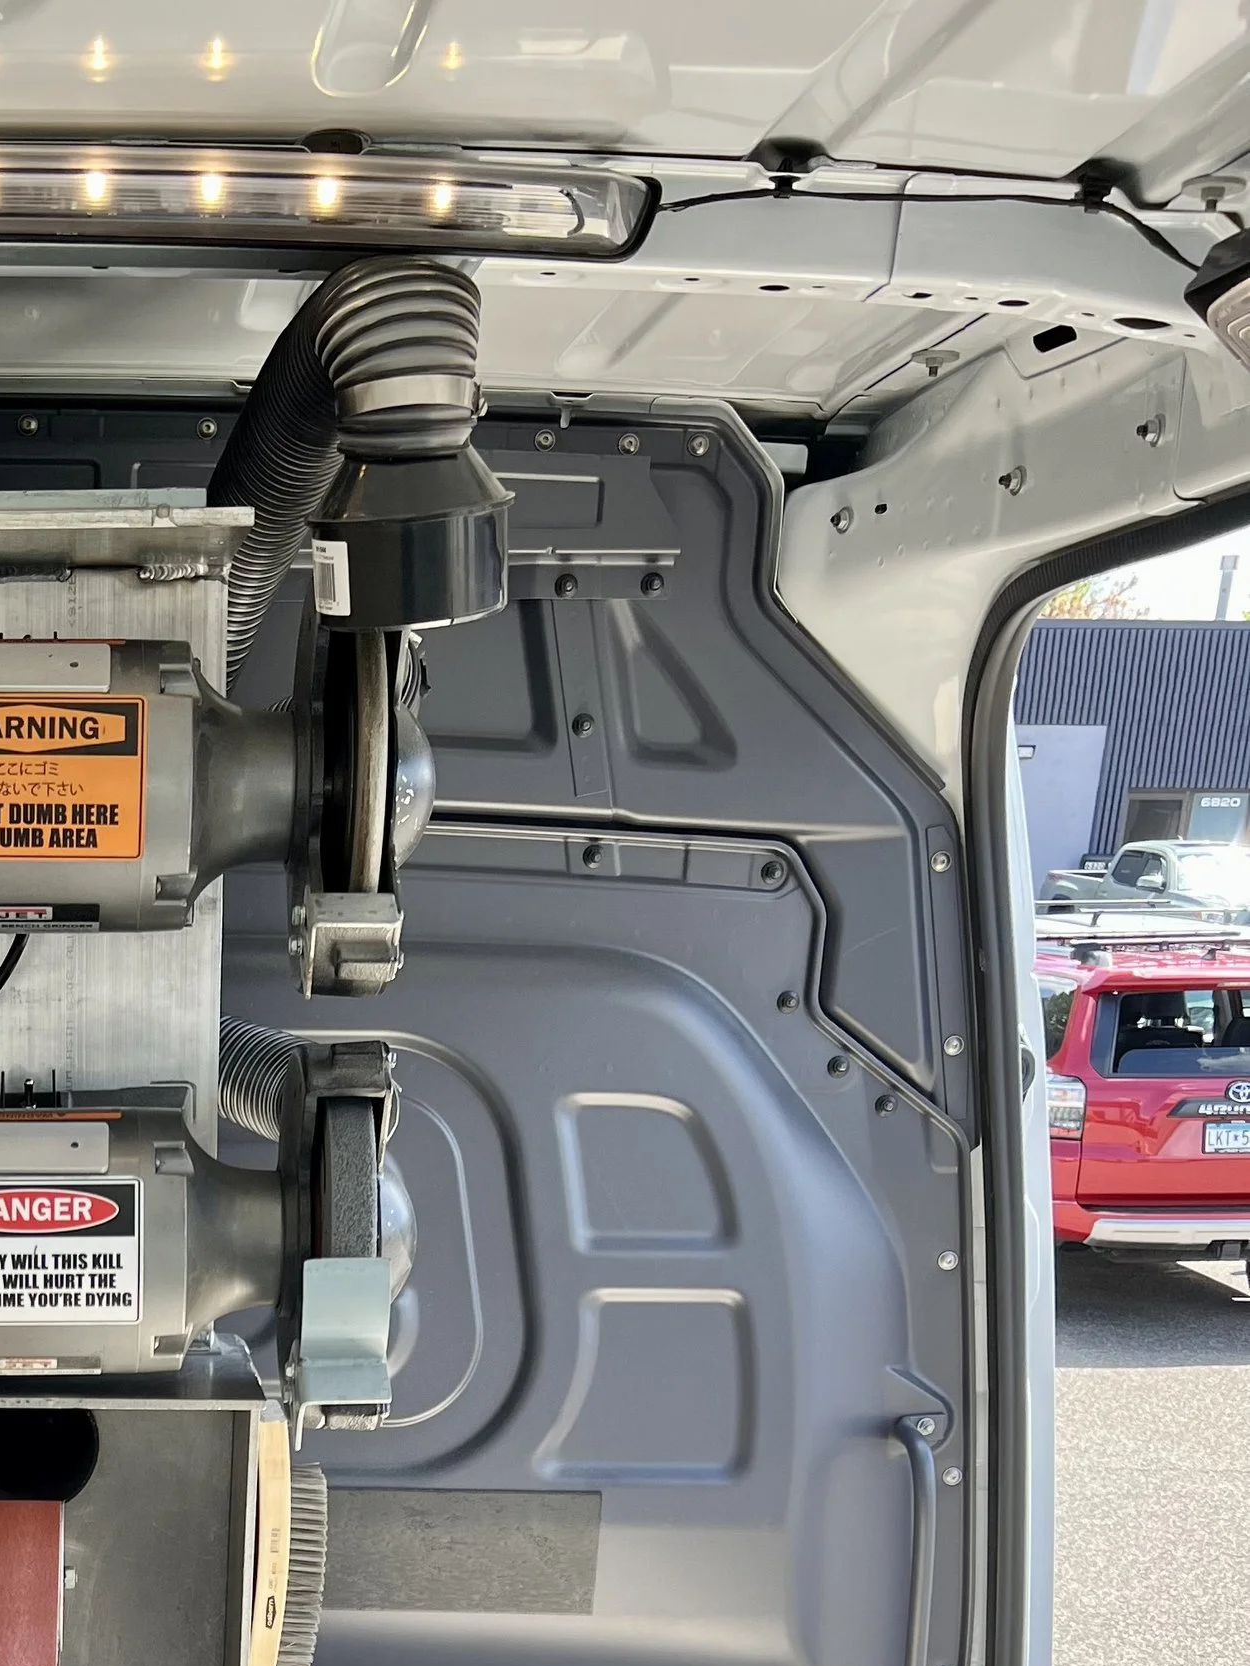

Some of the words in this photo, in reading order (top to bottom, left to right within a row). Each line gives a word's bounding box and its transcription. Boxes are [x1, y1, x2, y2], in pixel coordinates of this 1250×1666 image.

[1200, 797, 1241, 808] 6820
[9, 804, 67, 825] DUMB
[71, 804, 119, 826] HERE
[48, 828, 98, 849] AREA
[11, 1254, 48, 1270] WILL
[52, 1253, 88, 1270] THIS
[92, 1253, 123, 1269] KILL
[2, 1274, 39, 1289] WILL
[43, 1274, 85, 1289] HURT
[88, 1273, 116, 1289] THE
[28, 1293, 82, 1307] YOU'RE
[85, 1292, 132, 1307] DYING
